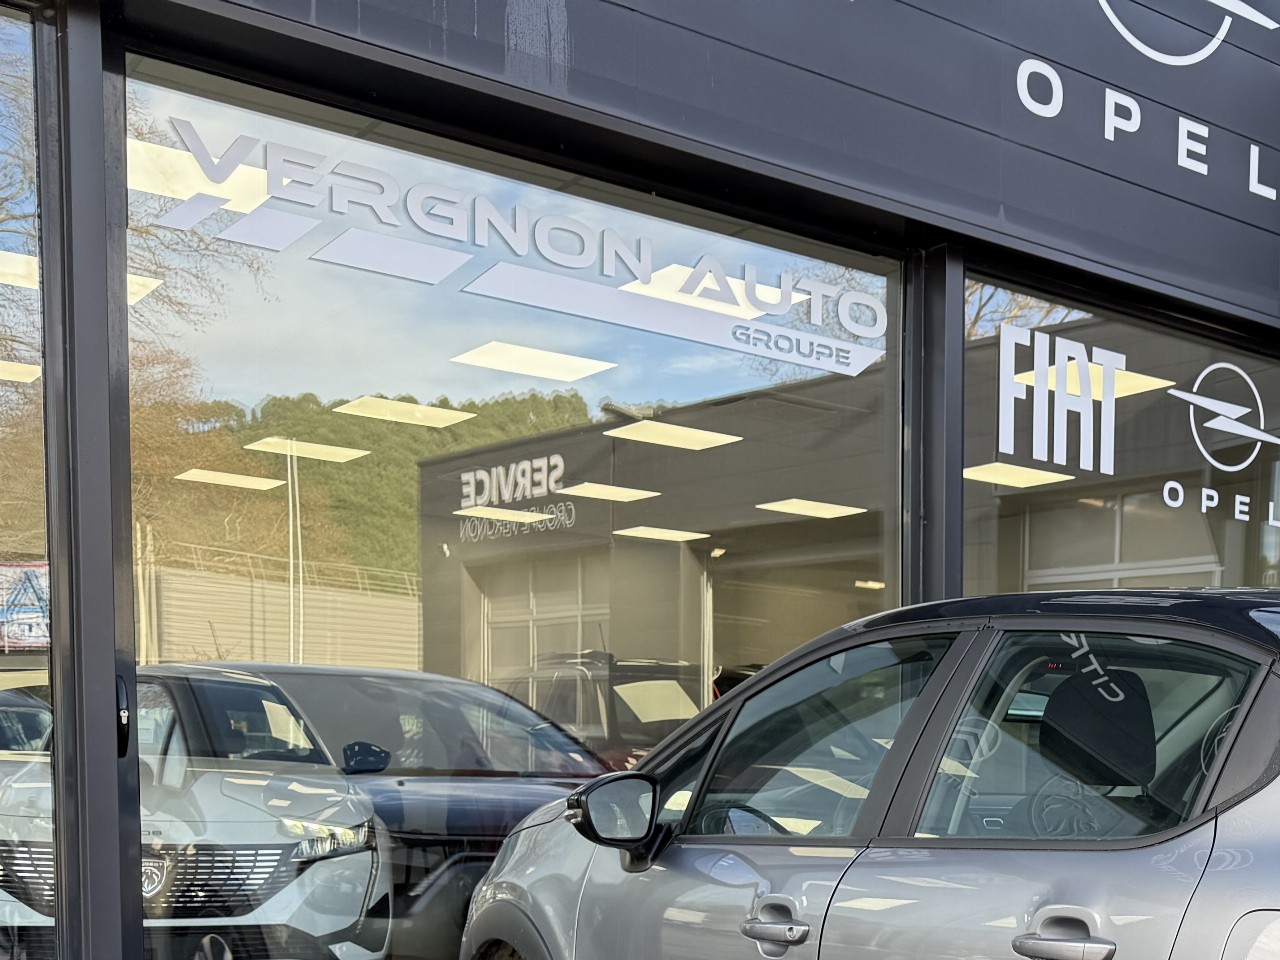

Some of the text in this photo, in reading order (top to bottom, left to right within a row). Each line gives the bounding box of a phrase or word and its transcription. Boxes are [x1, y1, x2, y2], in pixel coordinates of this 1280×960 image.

[1016, 59, 1277, 201] OPEL
[168, 115, 888, 339] VERGNON AUTO
[731, 324, 852, 368] GROUPE
[998, 321, 1127, 476] FIAT
